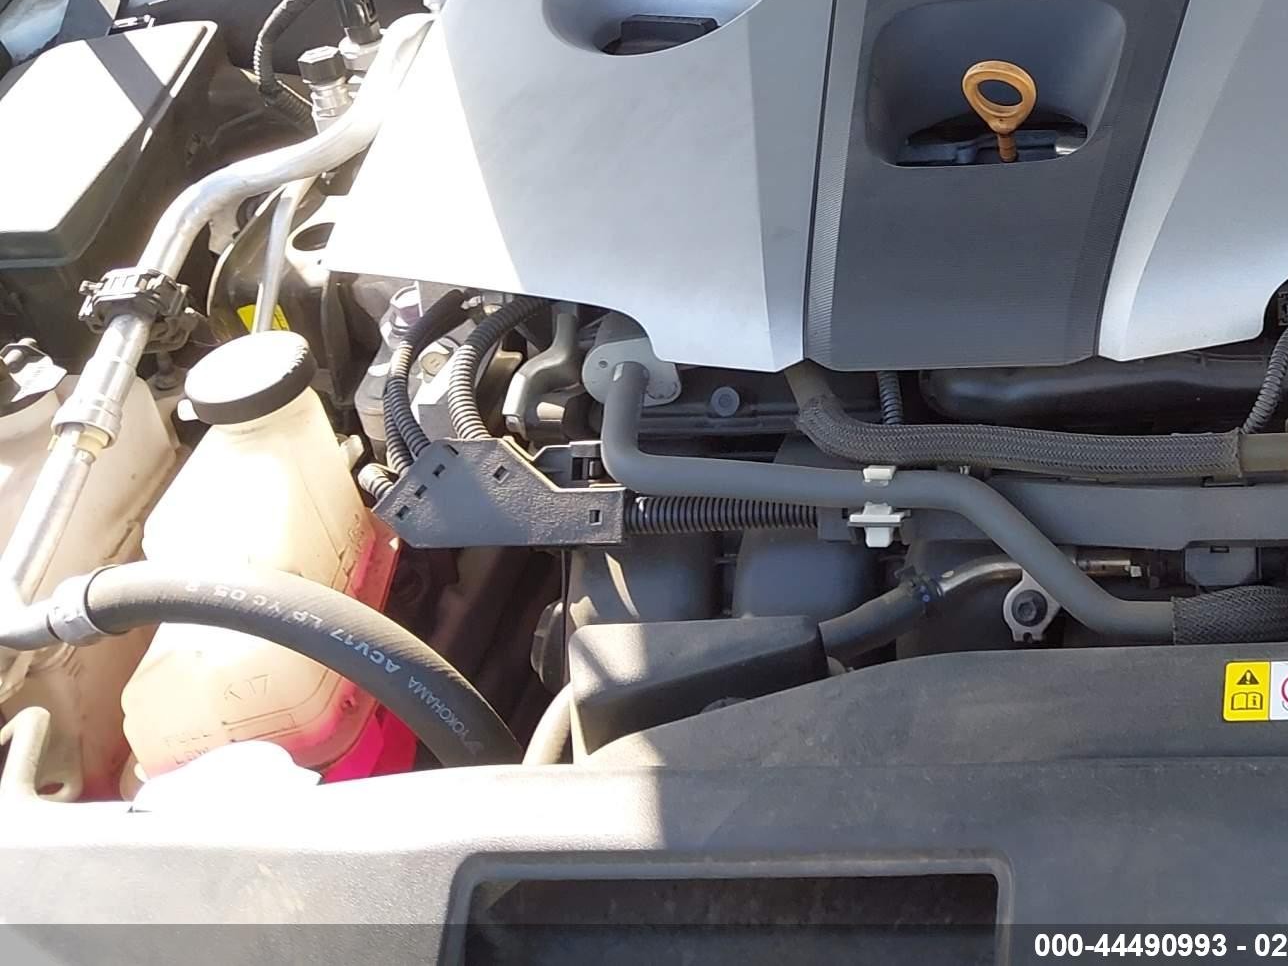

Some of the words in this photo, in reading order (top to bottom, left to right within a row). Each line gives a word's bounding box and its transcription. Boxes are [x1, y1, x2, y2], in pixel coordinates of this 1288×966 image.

[292, 610, 323, 628] LP
[330, 628, 401, 674] ACV17
[408, 676, 470, 742] YOKOHAMA
